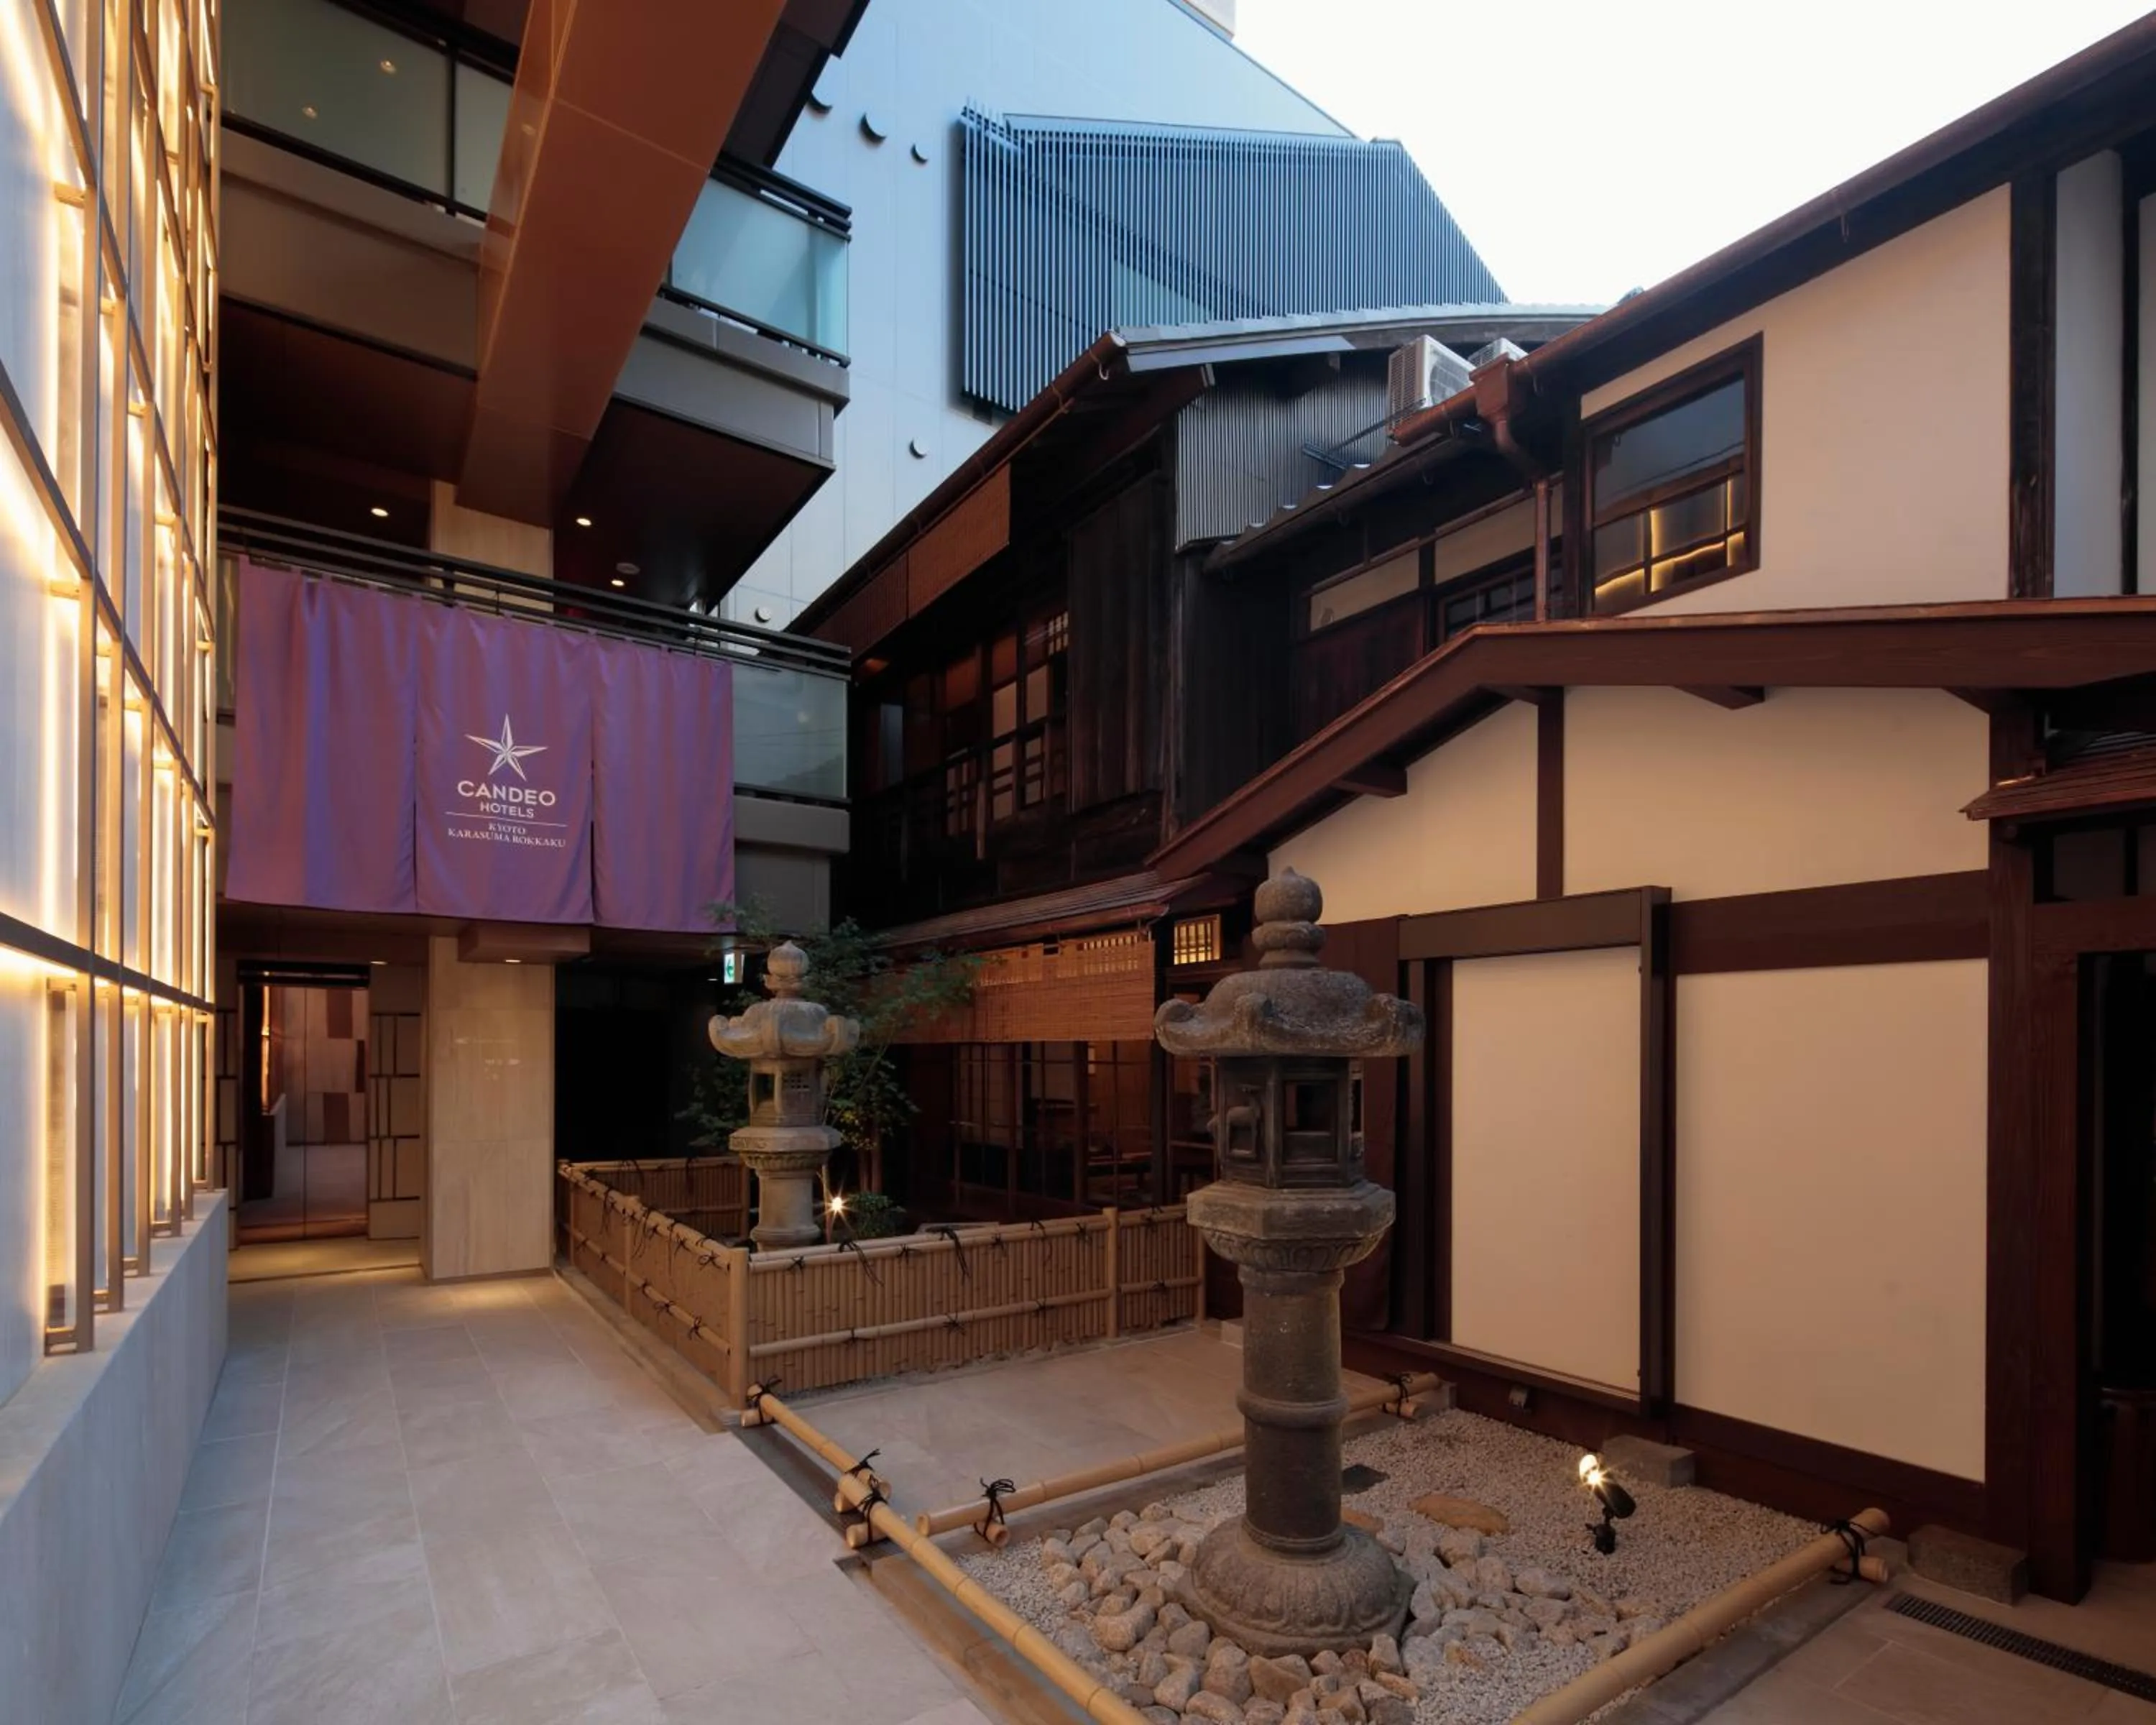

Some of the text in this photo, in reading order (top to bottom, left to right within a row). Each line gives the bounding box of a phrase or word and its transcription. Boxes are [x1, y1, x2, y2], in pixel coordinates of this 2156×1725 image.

[457, 780, 556, 806] CANDEO
[480, 801, 534, 819] HOTELS
[448, 828, 566, 847] KARASUMA ROKKAKU
[489, 822, 525, 835] KYOTO
